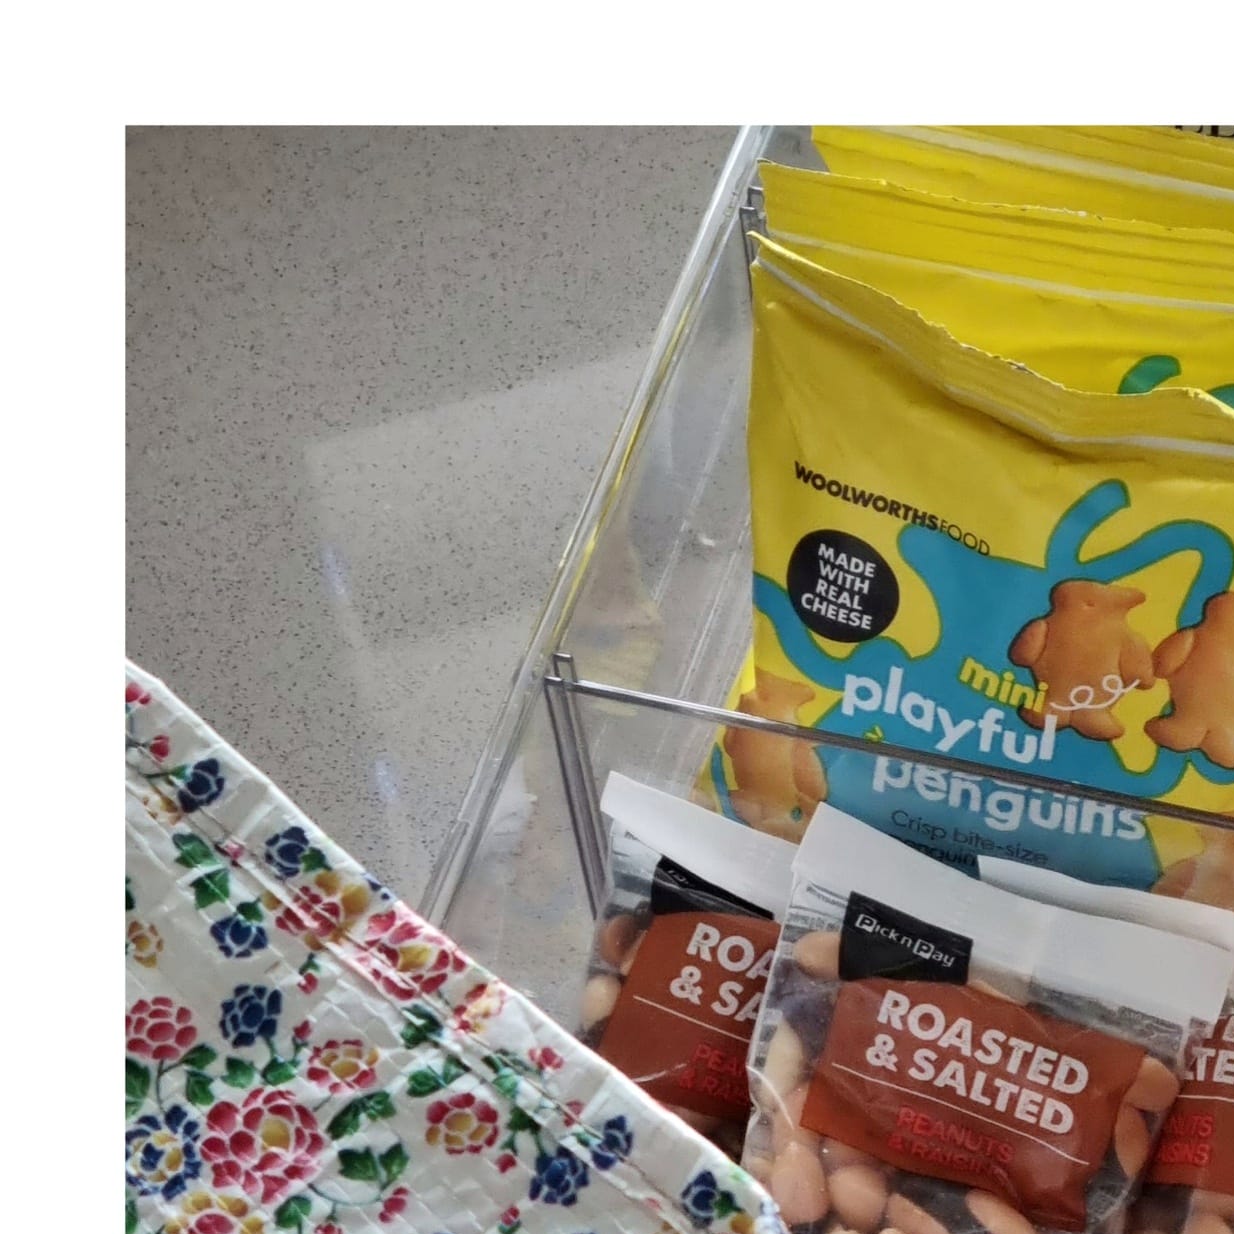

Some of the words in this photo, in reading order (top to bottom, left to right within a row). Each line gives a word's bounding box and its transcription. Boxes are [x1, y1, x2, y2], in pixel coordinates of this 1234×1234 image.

[818, 543, 877, 578] MADE
[819, 560, 870, 594] WITH
[801, 593, 873, 631] CHEESE
[815, 579, 864, 611] REAL
[959, 657, 1048, 713] mini
[841, 665, 1058, 764] playful
[872, 756, 1147, 840] penguins
[891, 809, 947, 841] Crisp
[953, 827, 1049, 866] bite-size
[669, 965, 704, 1005] &
[876, 989, 1089, 1095] ROASTED
[865, 1033, 899, 1072] &
[908, 1049, 1075, 1135] SALTED
[898, 1105, 1015, 1165] PEANUTS
